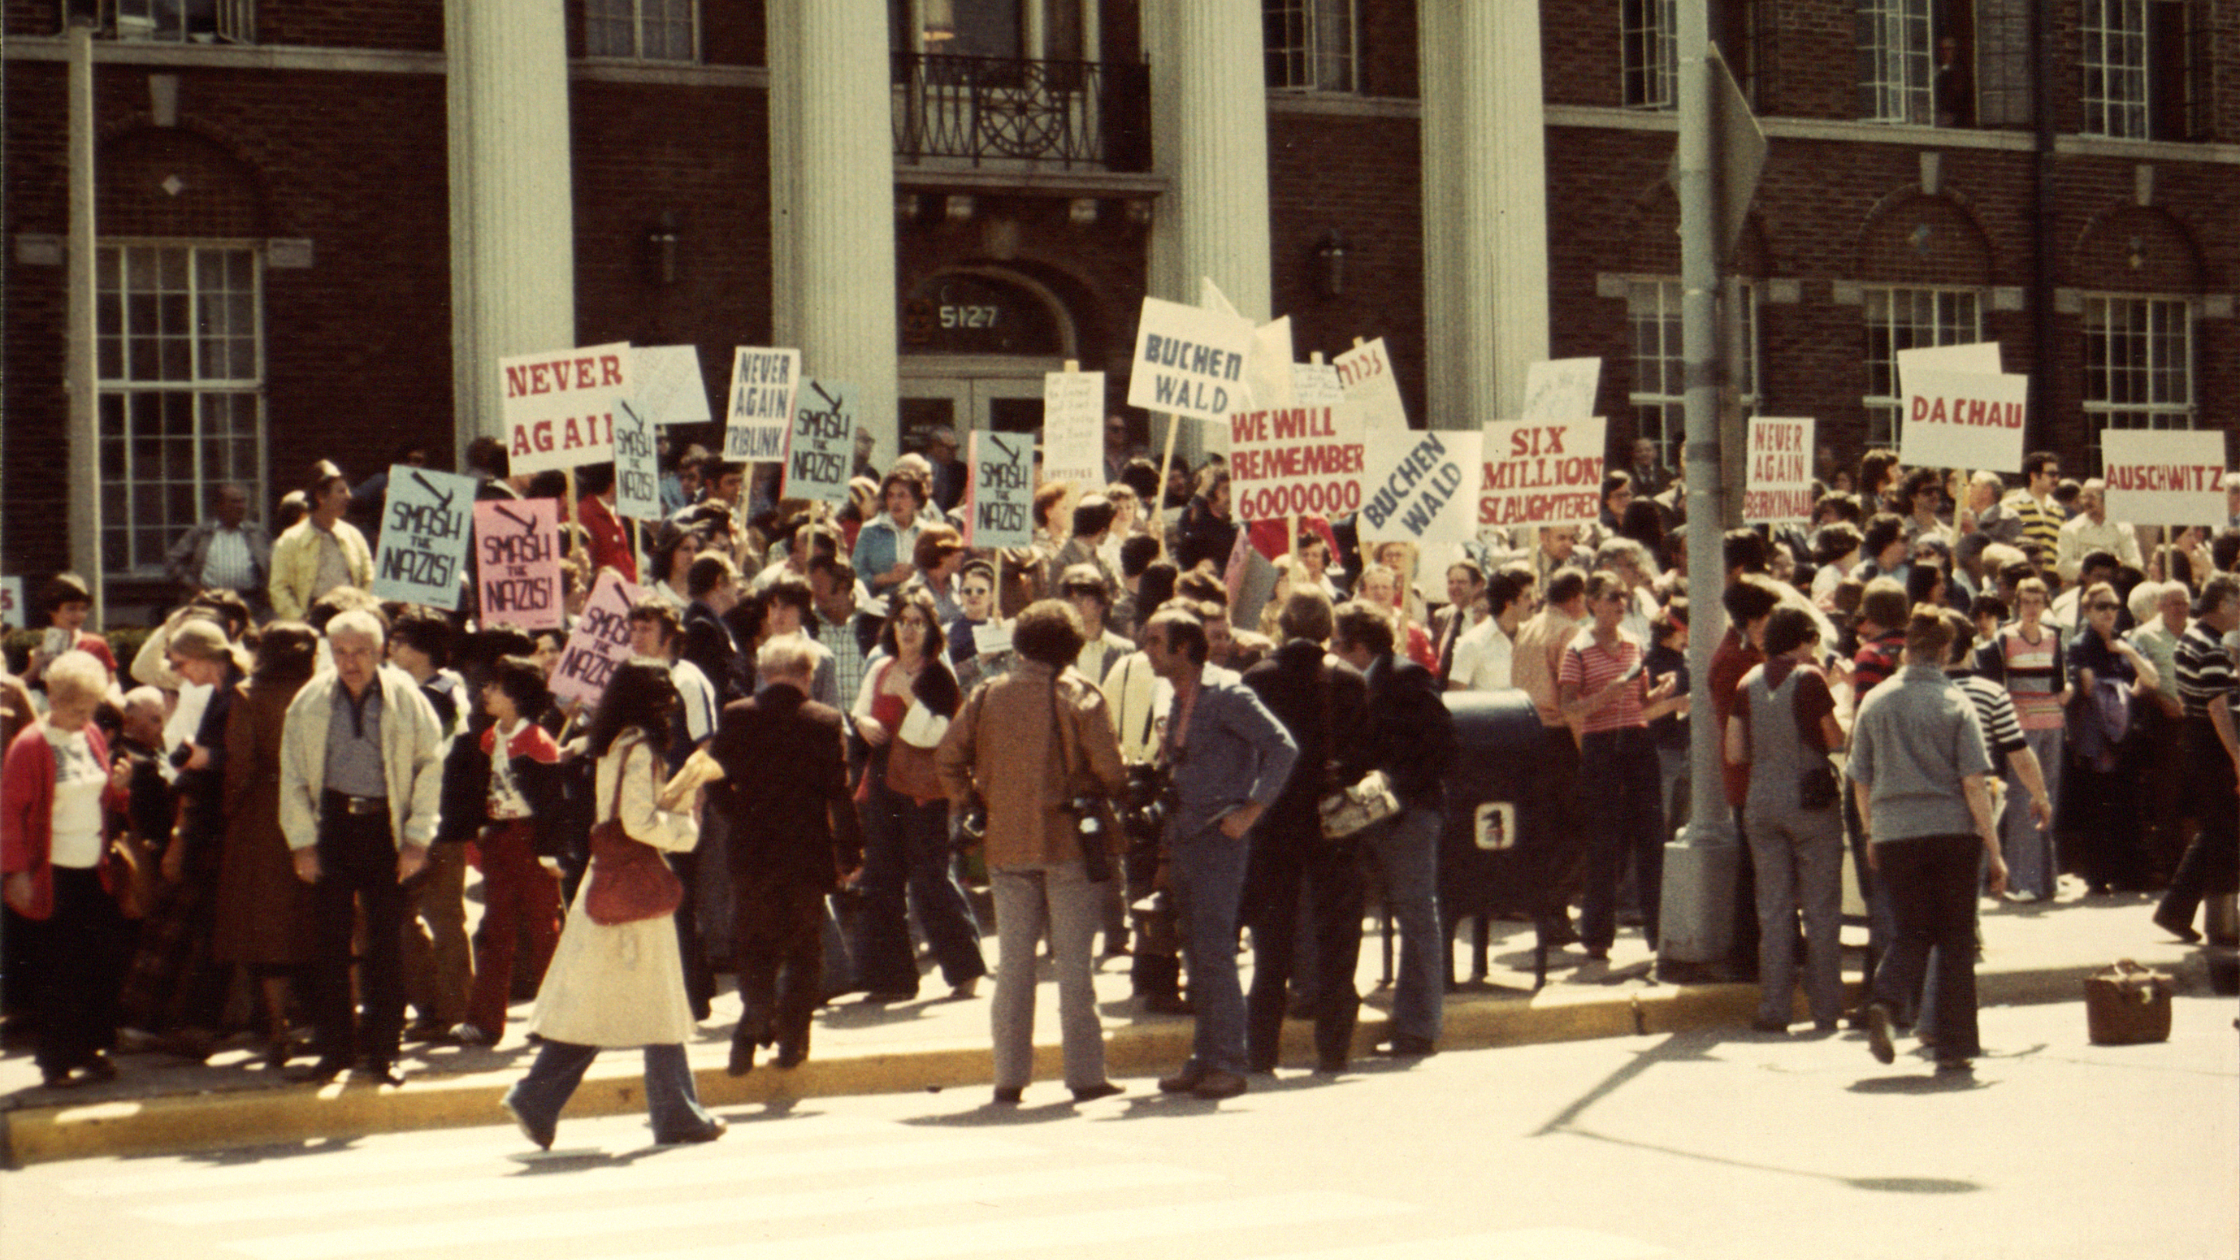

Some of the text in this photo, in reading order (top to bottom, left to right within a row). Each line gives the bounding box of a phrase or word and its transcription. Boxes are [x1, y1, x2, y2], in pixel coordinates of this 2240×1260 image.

[940, 306, 997, 328] 5127
[739, 353, 790, 384] NEVER
[1145, 333, 1242, 381] BUCHEN
[506, 355, 623, 398] NEVER
[735, 386, 788, 419] AGAIN
[1156, 374, 1228, 414] WALD
[796, 409, 850, 440] SMASH
[1231, 407, 1336, 443] WE WILL
[1911, 395, 2022, 429] DACHAU
[616, 429, 652, 458] SMASH
[812, 439, 828, 450] THE
[1510, 426, 1567, 458] SIX
[1755, 423, 1803, 452] NEVER
[792, 450, 845, 484] NAZIS!
[980, 462, 1027, 489] SMASH
[1231, 444, 1364, 480] REMEMBER
[1481, 456, 1603, 490] MILLION
[1754, 454, 1803, 482] AGAIN
[2104, 463, 2224, 492] AUSCHWITZ
[995, 489, 1010, 500] THE
[1362, 432, 1446, 530] BUCHEN
[1239, 479, 1361, 519] 6000000
[1401, 461, 1462, 537] WALD
[1478, 492, 1600, 525] SLAUGHTERED
[390, 501, 462, 540] SMASH
[978, 502, 1026, 532] NAZIS!
[411, 535, 432, 549] THE
[483, 533, 551, 565] SMASH
[381, 547, 456, 588] NAZIS!
[508, 565, 527, 576] THE
[486, 577, 552, 613] NAZIS!
[581, 607, 631, 645] SMAS
[593, 639, 612, 654] THE
